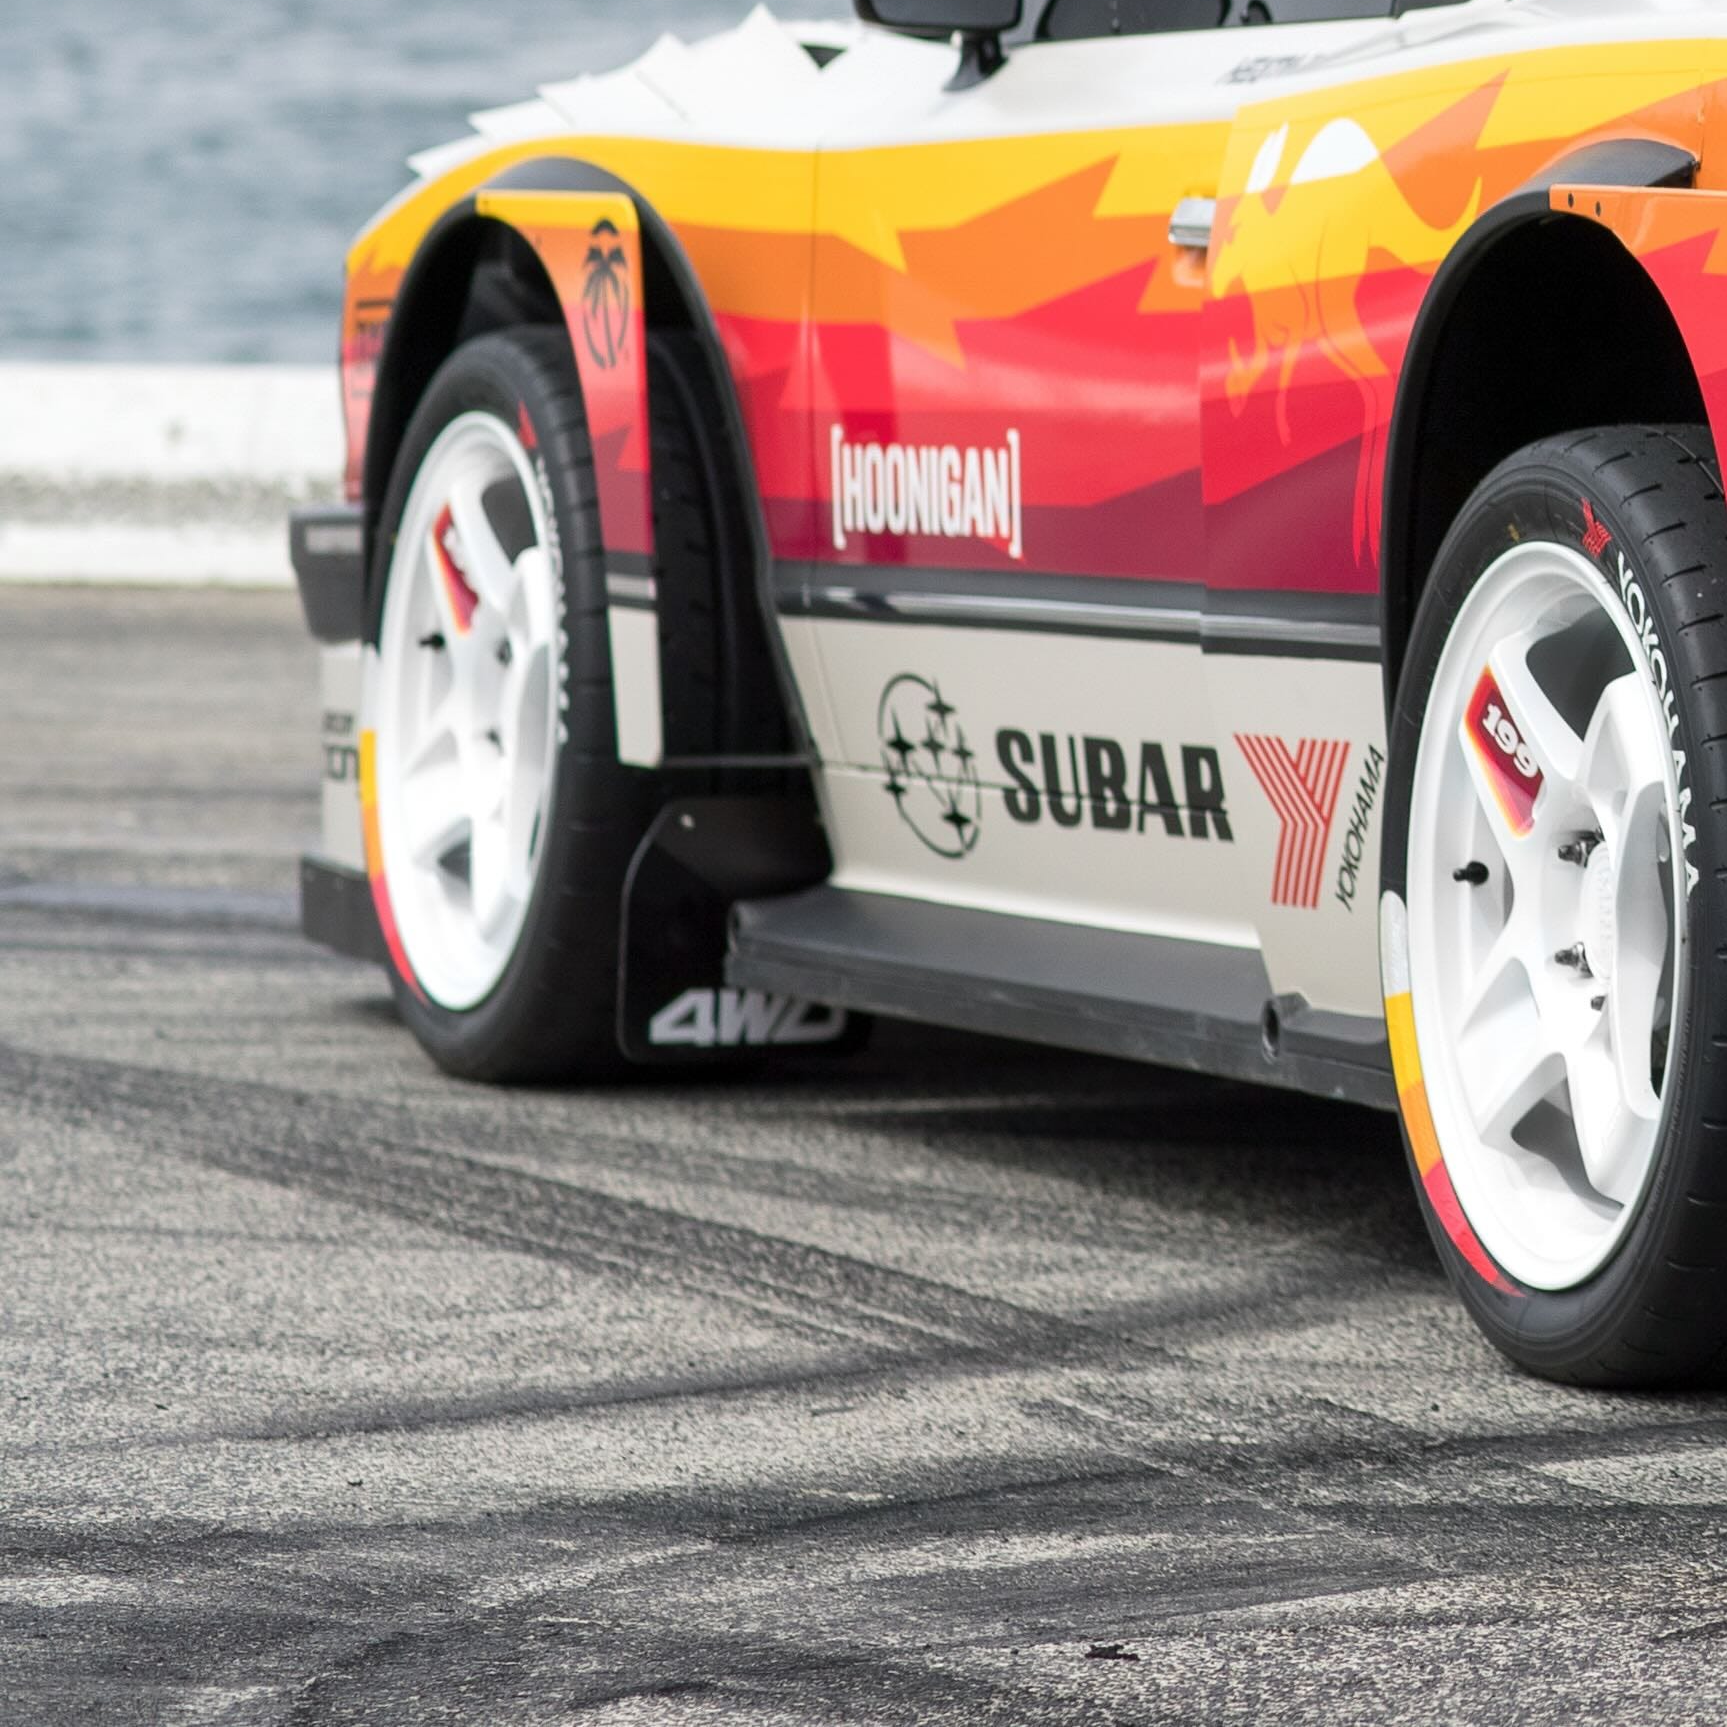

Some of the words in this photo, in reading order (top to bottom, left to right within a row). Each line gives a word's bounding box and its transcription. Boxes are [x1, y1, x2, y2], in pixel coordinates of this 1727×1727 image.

[1481, 703, 1540, 778] 199
[1335, 743, 1385, 913] YOKOHAMA
[648, 986, 850, 1048] 4WD
